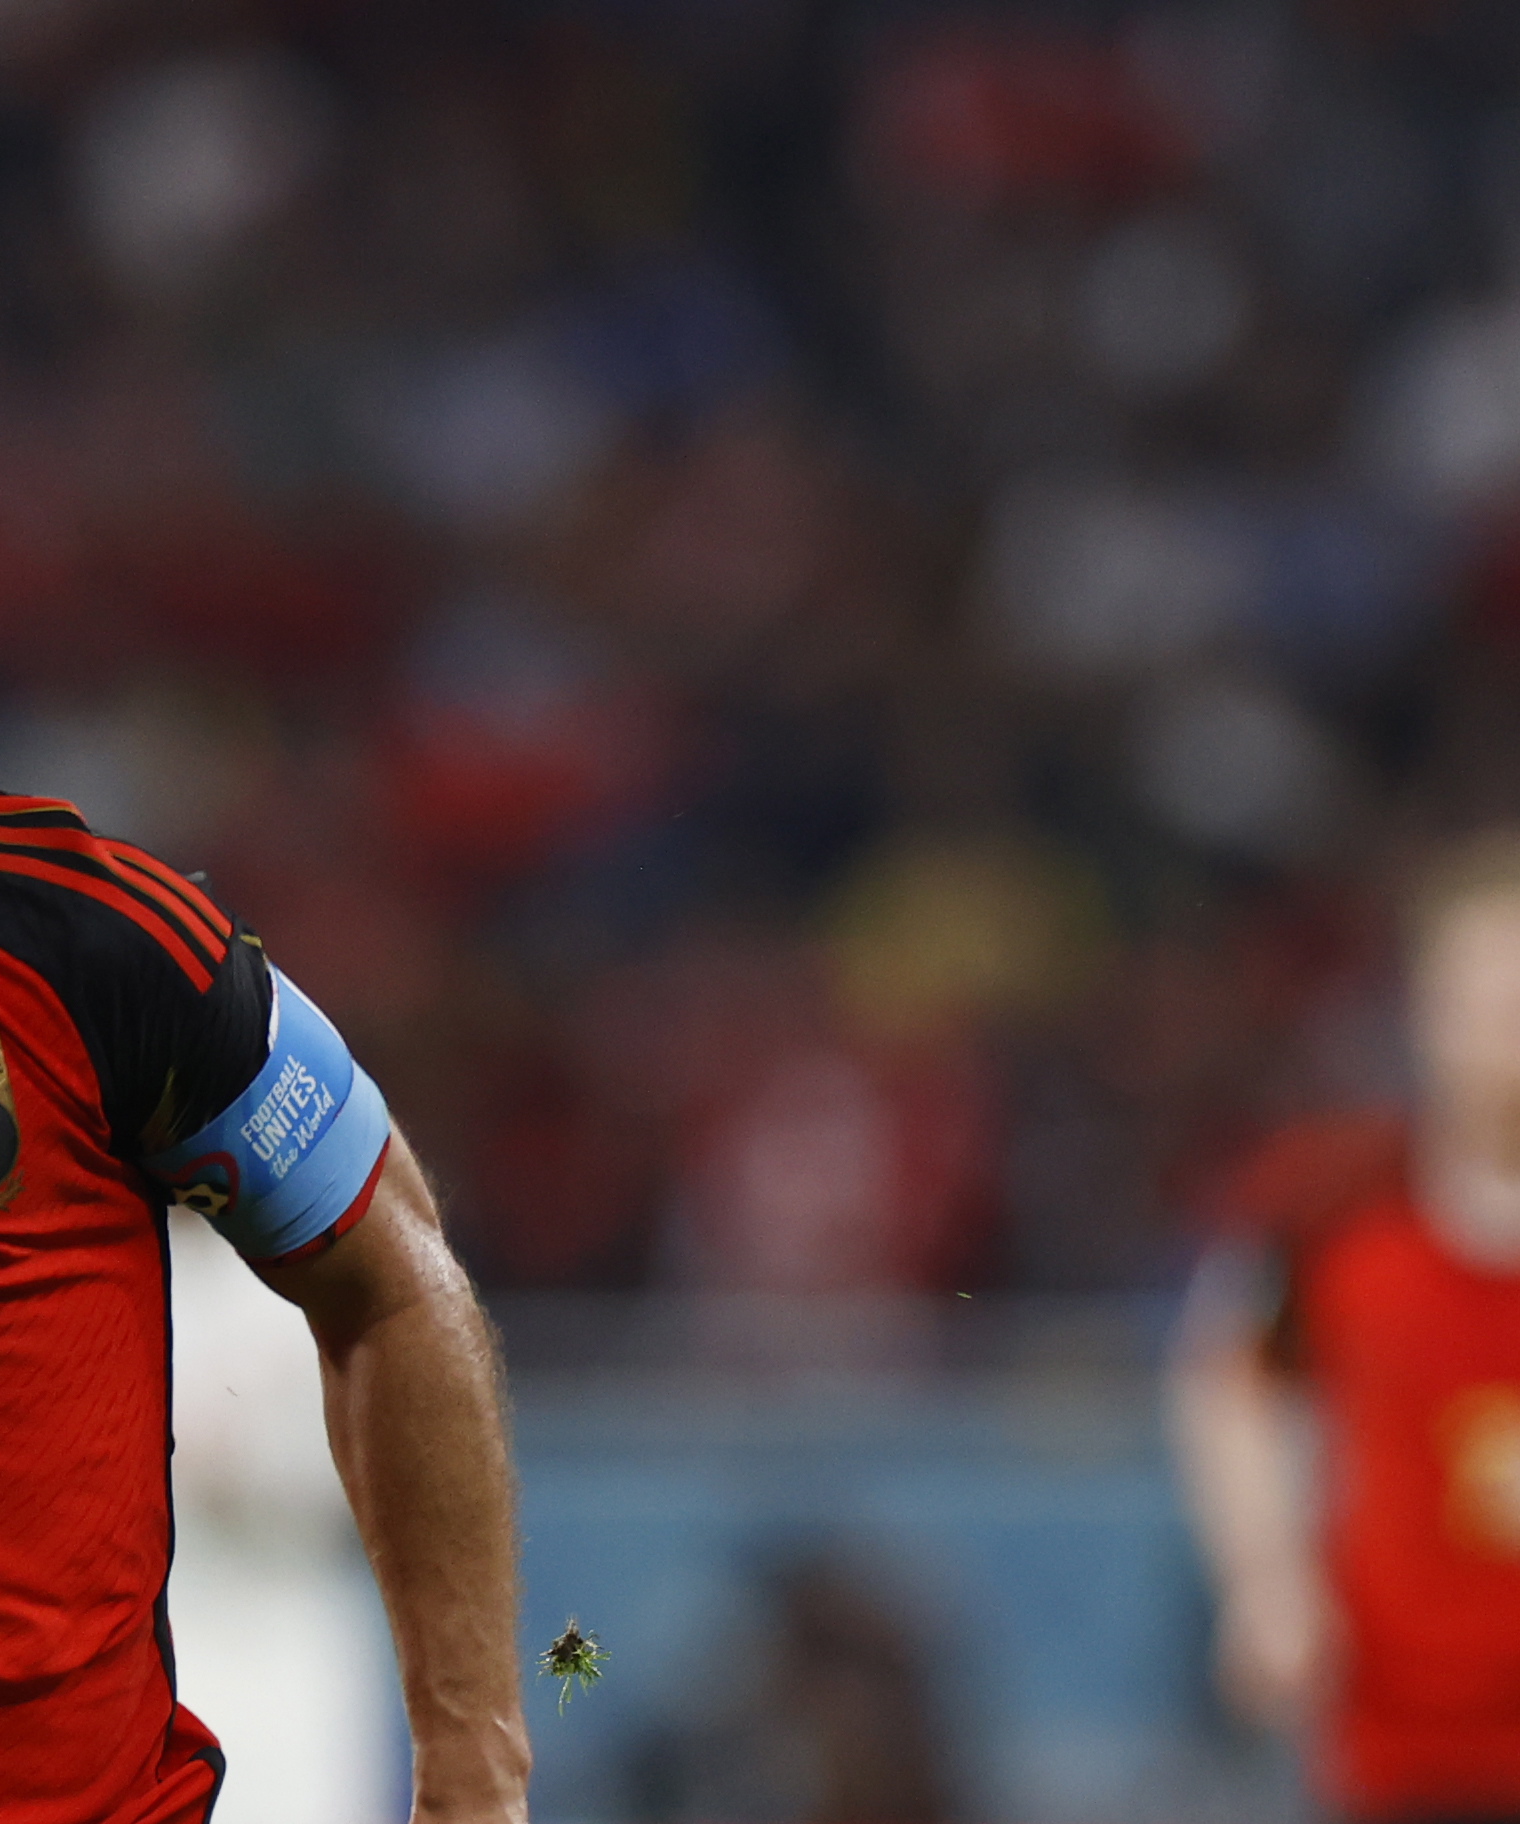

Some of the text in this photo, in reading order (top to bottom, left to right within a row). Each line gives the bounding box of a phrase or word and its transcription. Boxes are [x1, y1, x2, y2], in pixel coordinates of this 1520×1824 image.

[240, 1055, 301, 1142] FOOTBALL
[251, 1066, 317, 1161] UNITES
[271, 1083, 335, 1179] the World
